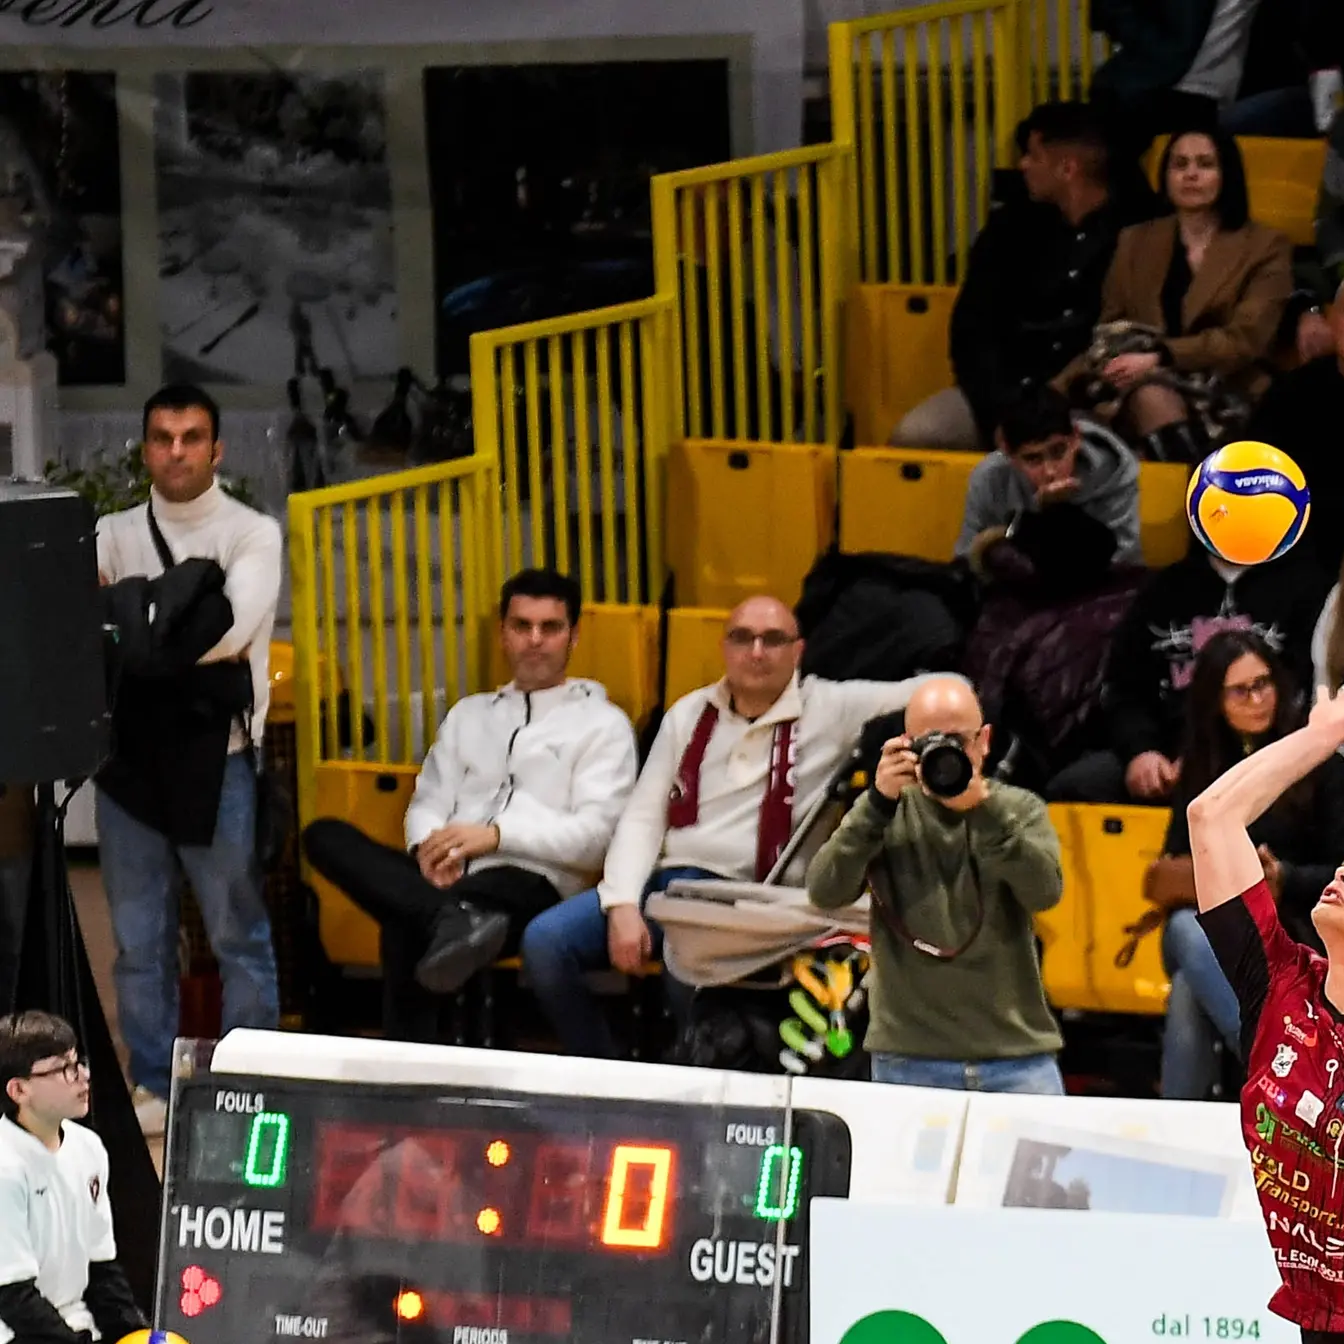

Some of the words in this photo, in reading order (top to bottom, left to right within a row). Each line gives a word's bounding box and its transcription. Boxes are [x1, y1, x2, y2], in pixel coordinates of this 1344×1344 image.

[216, 1090, 264, 1113] FOULS
[245, 1111, 289, 1187] 0
[726, 1123, 775, 1146] FOULS
[603, 1145, 672, 1247] 0
[756, 1145, 803, 1219] 0
[1255, 1170, 1338, 1223] Transport
[179, 1204, 285, 1254] HOME
[690, 1238, 800, 1287] GUEST
[275, 1315, 328, 1338] TIME-OUT
[1152, 1314, 1190, 1338] dal
[1203, 1317, 1262, 1340] 1894
